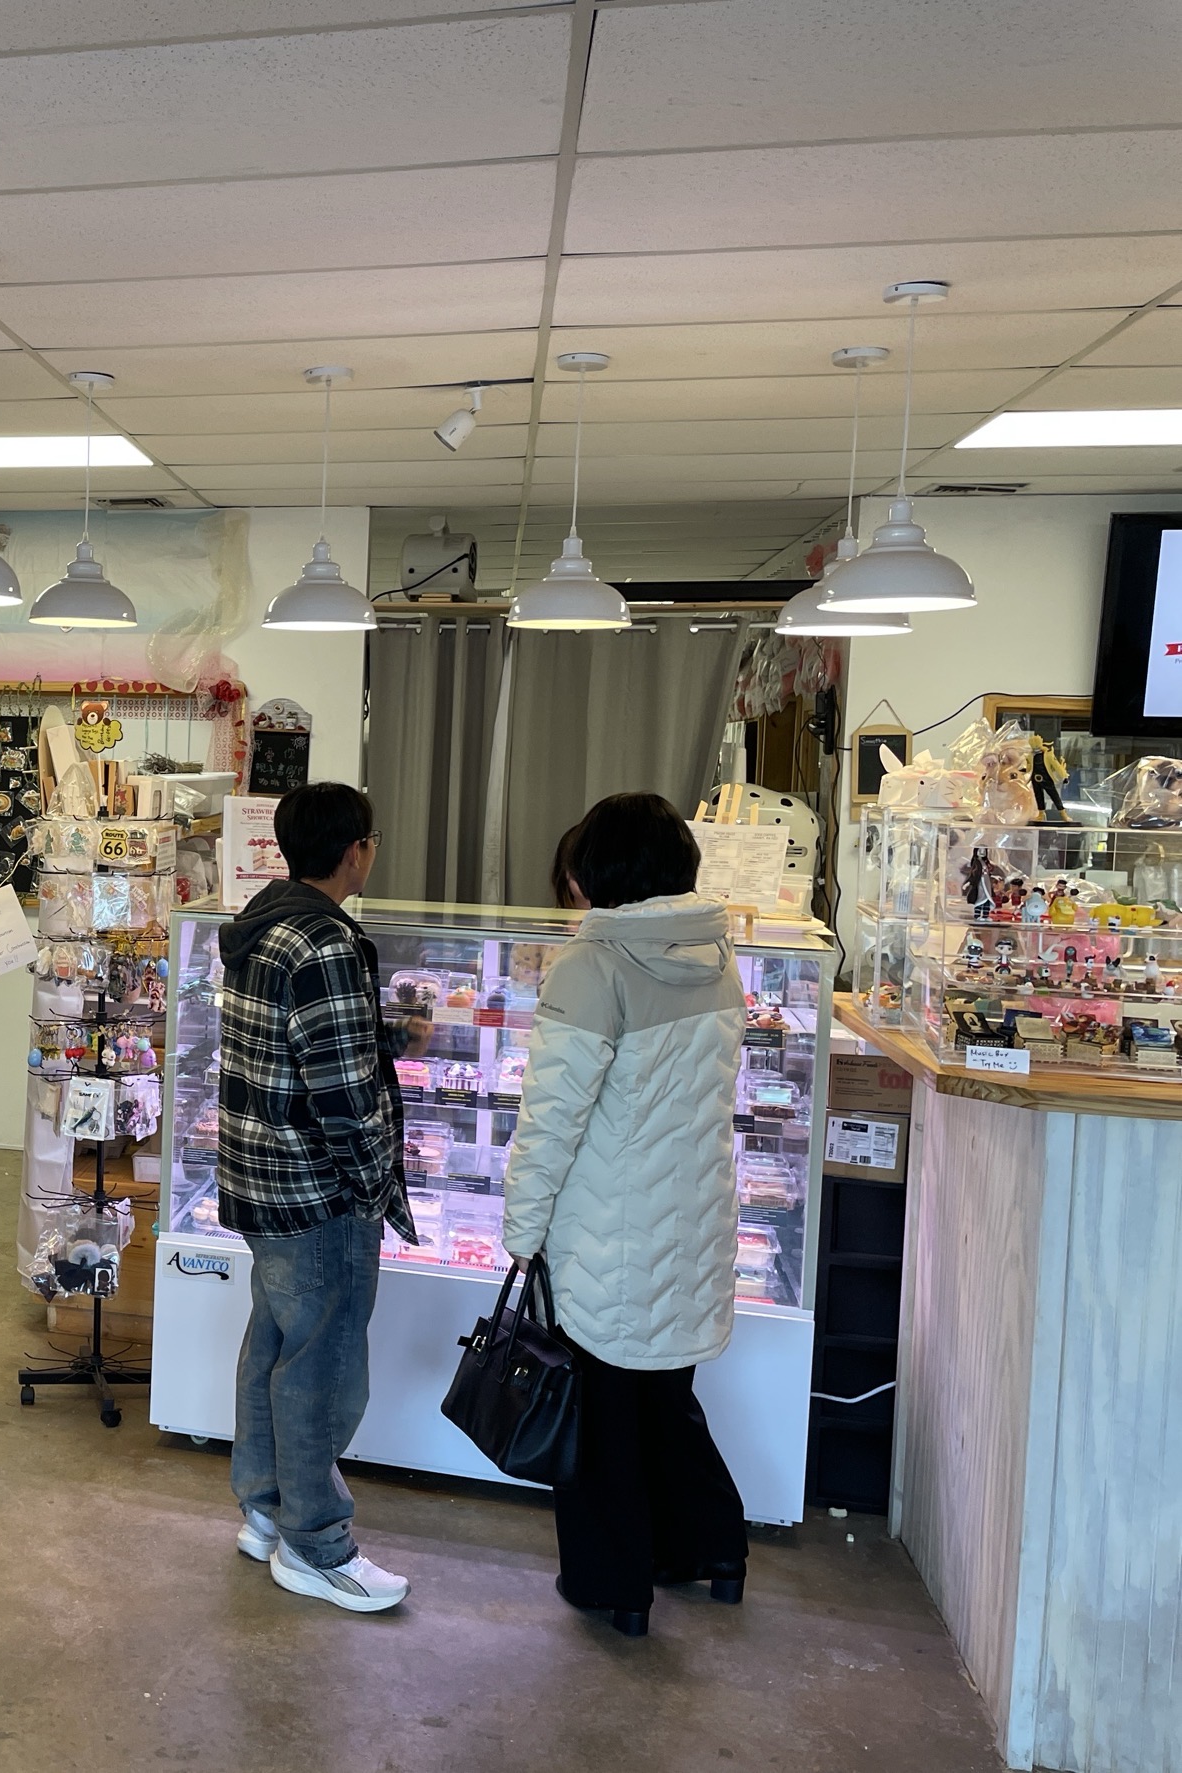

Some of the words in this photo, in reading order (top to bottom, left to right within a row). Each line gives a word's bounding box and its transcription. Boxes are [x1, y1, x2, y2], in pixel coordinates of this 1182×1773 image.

[241, 807, 275, 815] STRAWBE
[104, 841, 124, 856] 66
[970, 1049, 994, 1057] Music
[979, 1059, 991, 1069] Try
[993, 1061, 1005, 1069] Me
[195, 1253, 231, 1262] REFRIGERATION
[167, 1251, 230, 1281] AVANTCO
